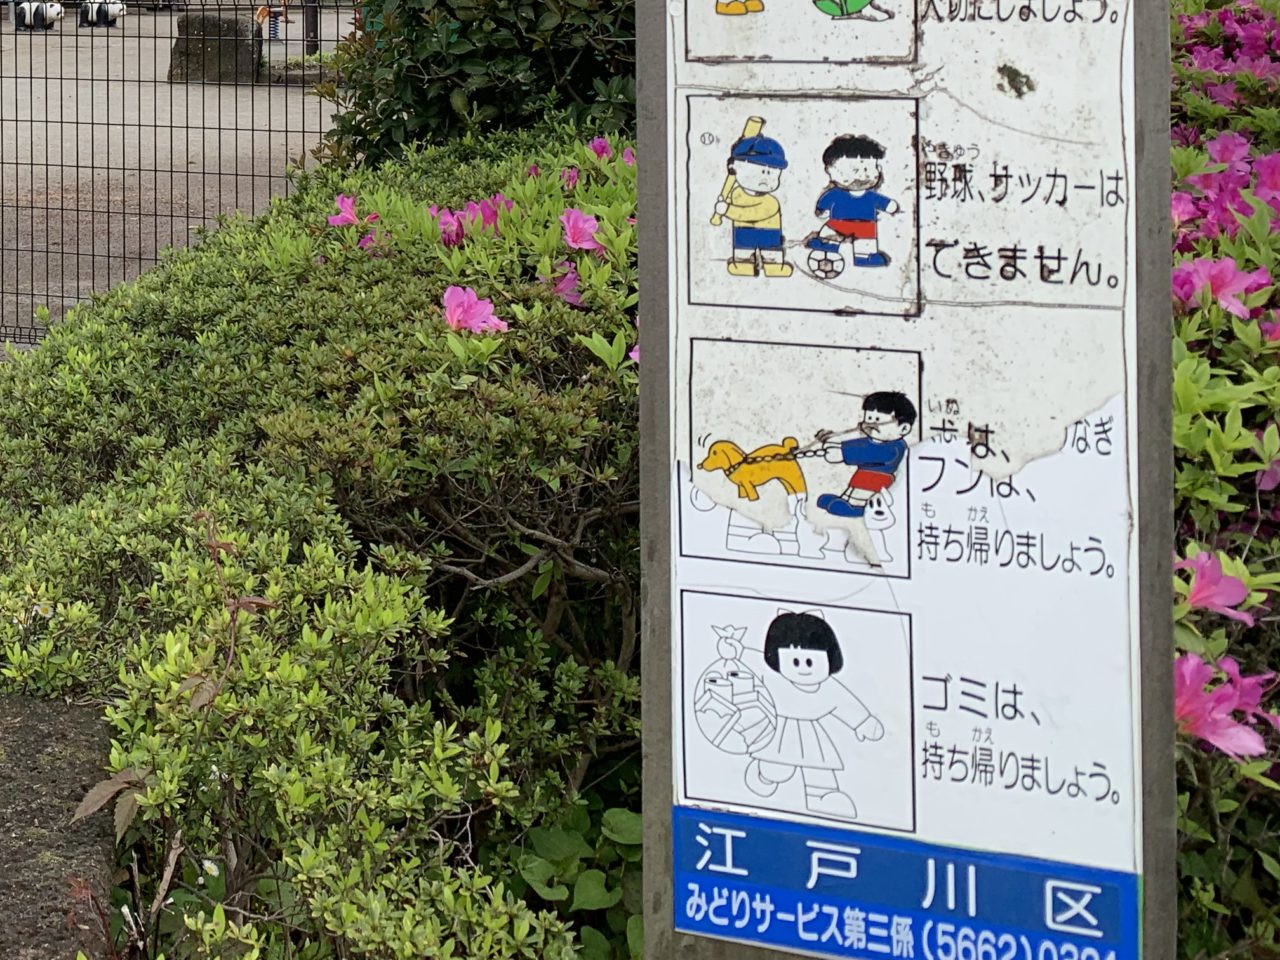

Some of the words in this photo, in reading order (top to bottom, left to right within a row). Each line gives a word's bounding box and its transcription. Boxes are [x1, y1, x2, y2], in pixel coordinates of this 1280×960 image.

[925, 161, 1124, 207] 野球、サッカーは
[925, 239, 1118, 288] できません。
[927, 399, 959, 415] いぬ
[918, 455, 1036, 502] フンは、
[921, 503, 936, 518] も
[968, 506, 989, 523] かえ
[917, 522, 1114, 579] 持ち帰りましょう。
[922, 673, 1040, 726] ゴミは、
[926, 721, 941, 738] も
[972, 726, 994, 745] かえ
[922, 741, 1119, 805] 持ち帰りましょう。
[695, 822, 1104, 938] 江戸川区
[685, 882, 1117, 960] みどりサービス第三係(5662)
